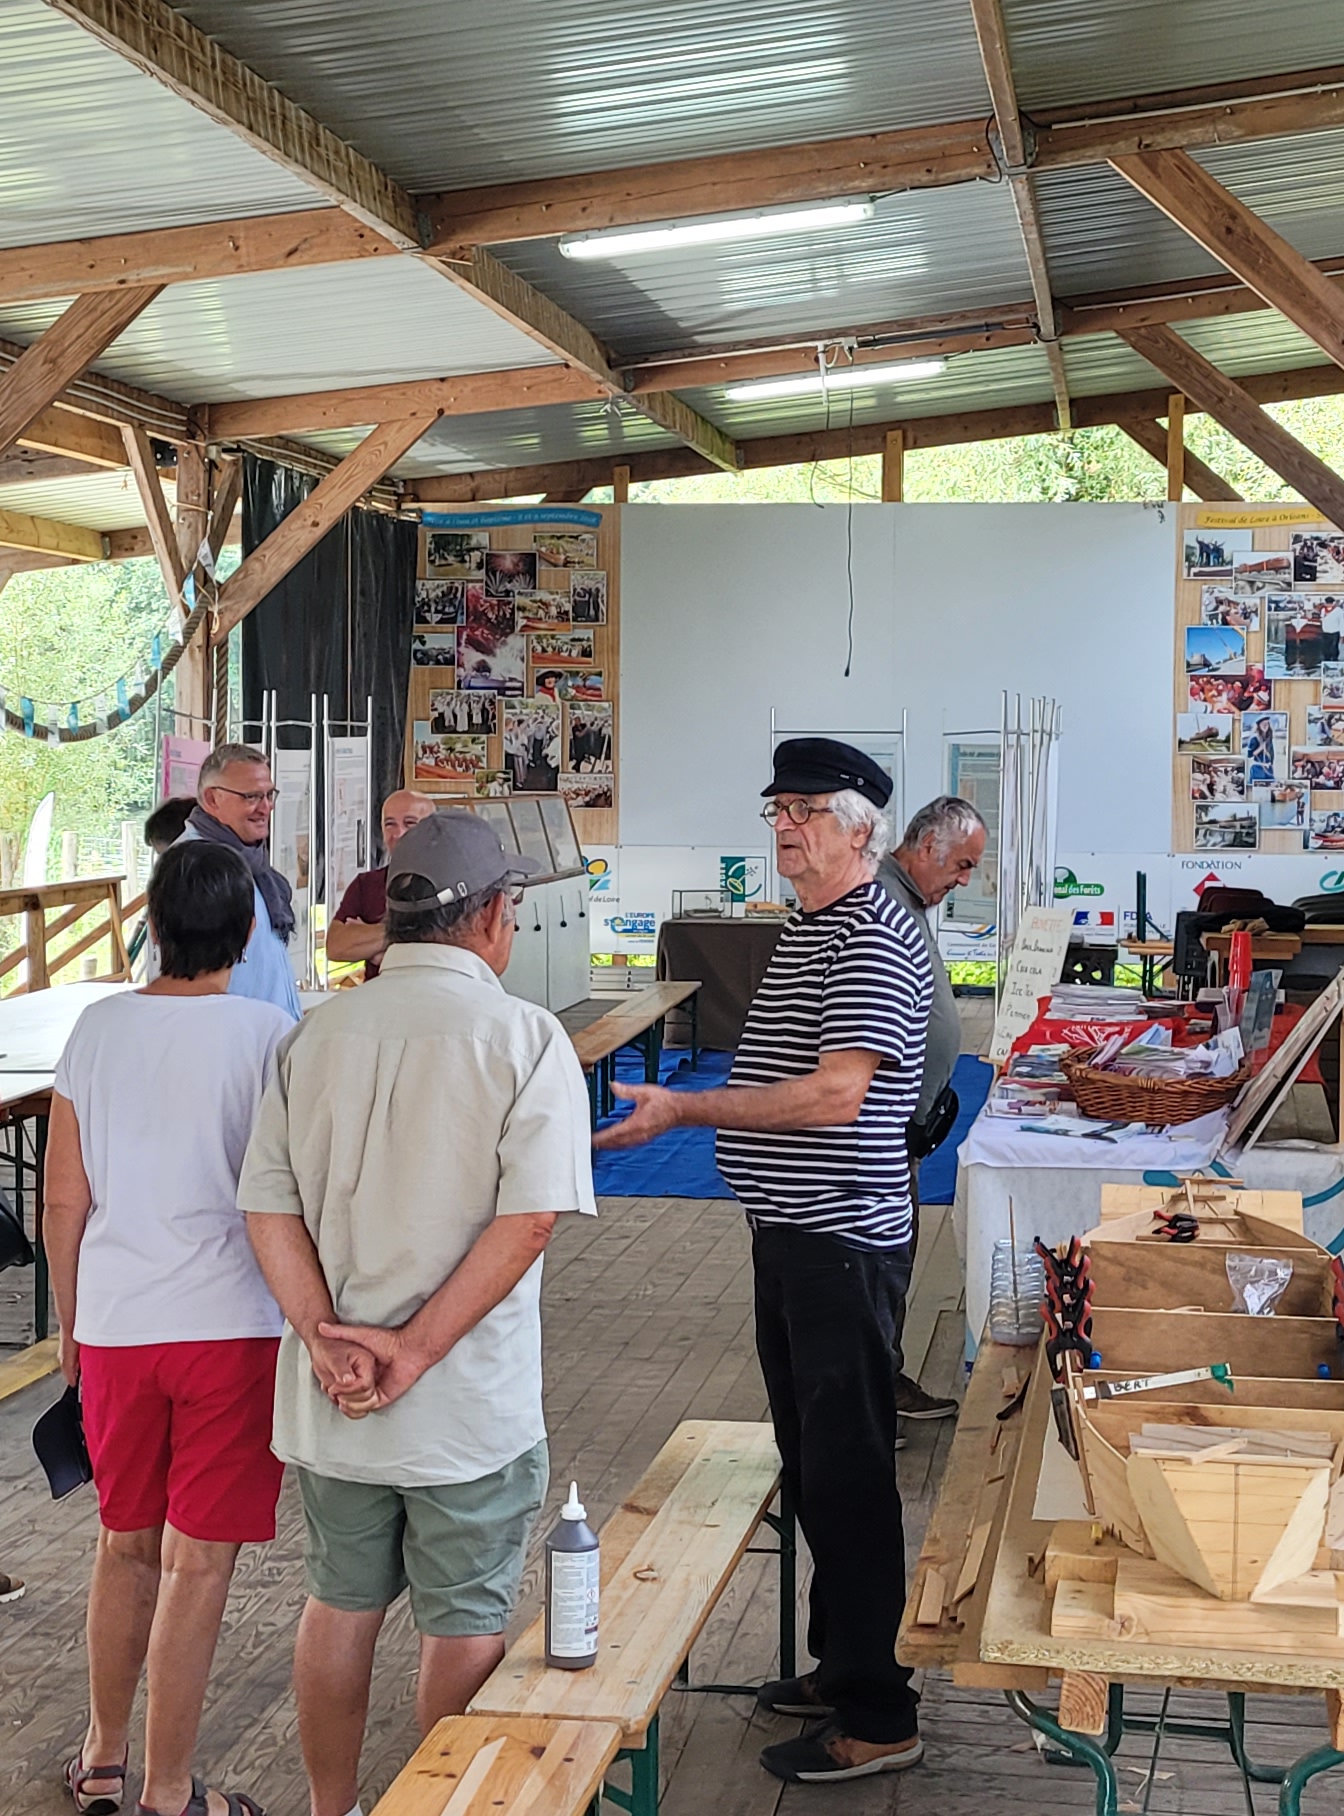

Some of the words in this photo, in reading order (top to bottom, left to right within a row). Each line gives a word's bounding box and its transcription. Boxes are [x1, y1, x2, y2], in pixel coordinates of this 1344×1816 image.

[1181, 860, 1242, 870] FONDATION
[1068, 883, 1080, 895] des
[1080, 884, 1102, 895] Forêts
[1123, 911, 1153, 921] FDA
